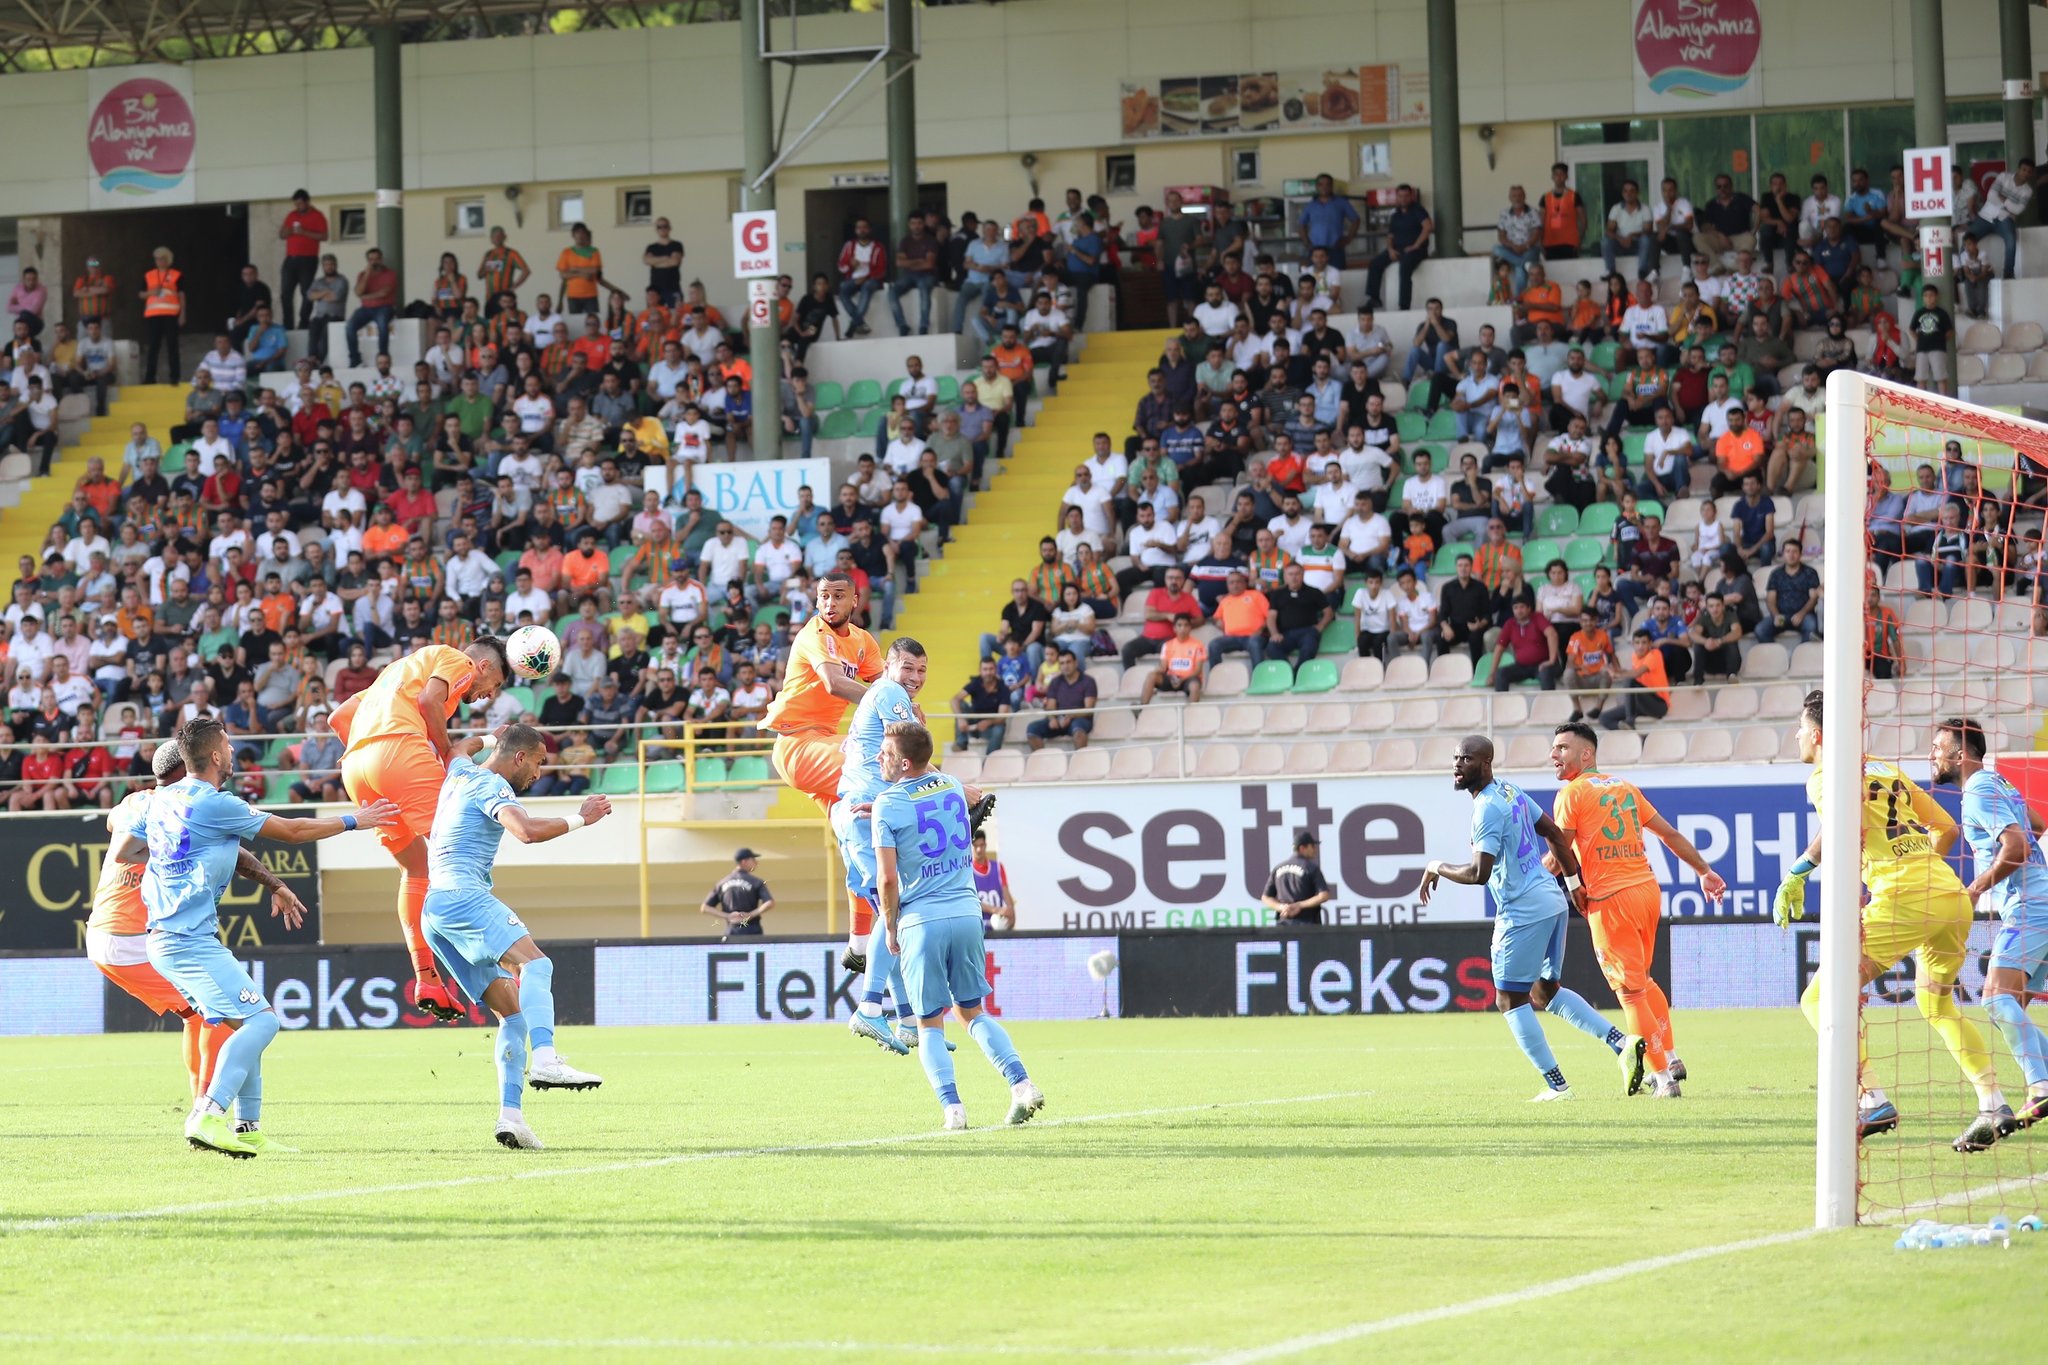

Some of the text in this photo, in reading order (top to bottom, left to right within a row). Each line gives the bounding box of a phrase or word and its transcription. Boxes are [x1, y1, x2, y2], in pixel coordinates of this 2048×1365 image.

[1912, 156, 1943, 193] H
[1911, 198, 1946, 211] BLOK
[742, 219, 769, 253] G
[740, 259, 772, 271] BLOK
[1925, 247, 1943, 267] H
[753, 299, 769, 318] G
[716, 469, 808, 513] BAU
[917, 777, 945, 793] aksa
[914, 792, 971, 859] 53
[1599, 792, 1640, 841] 31
[1058, 782, 1426, 907] sette
